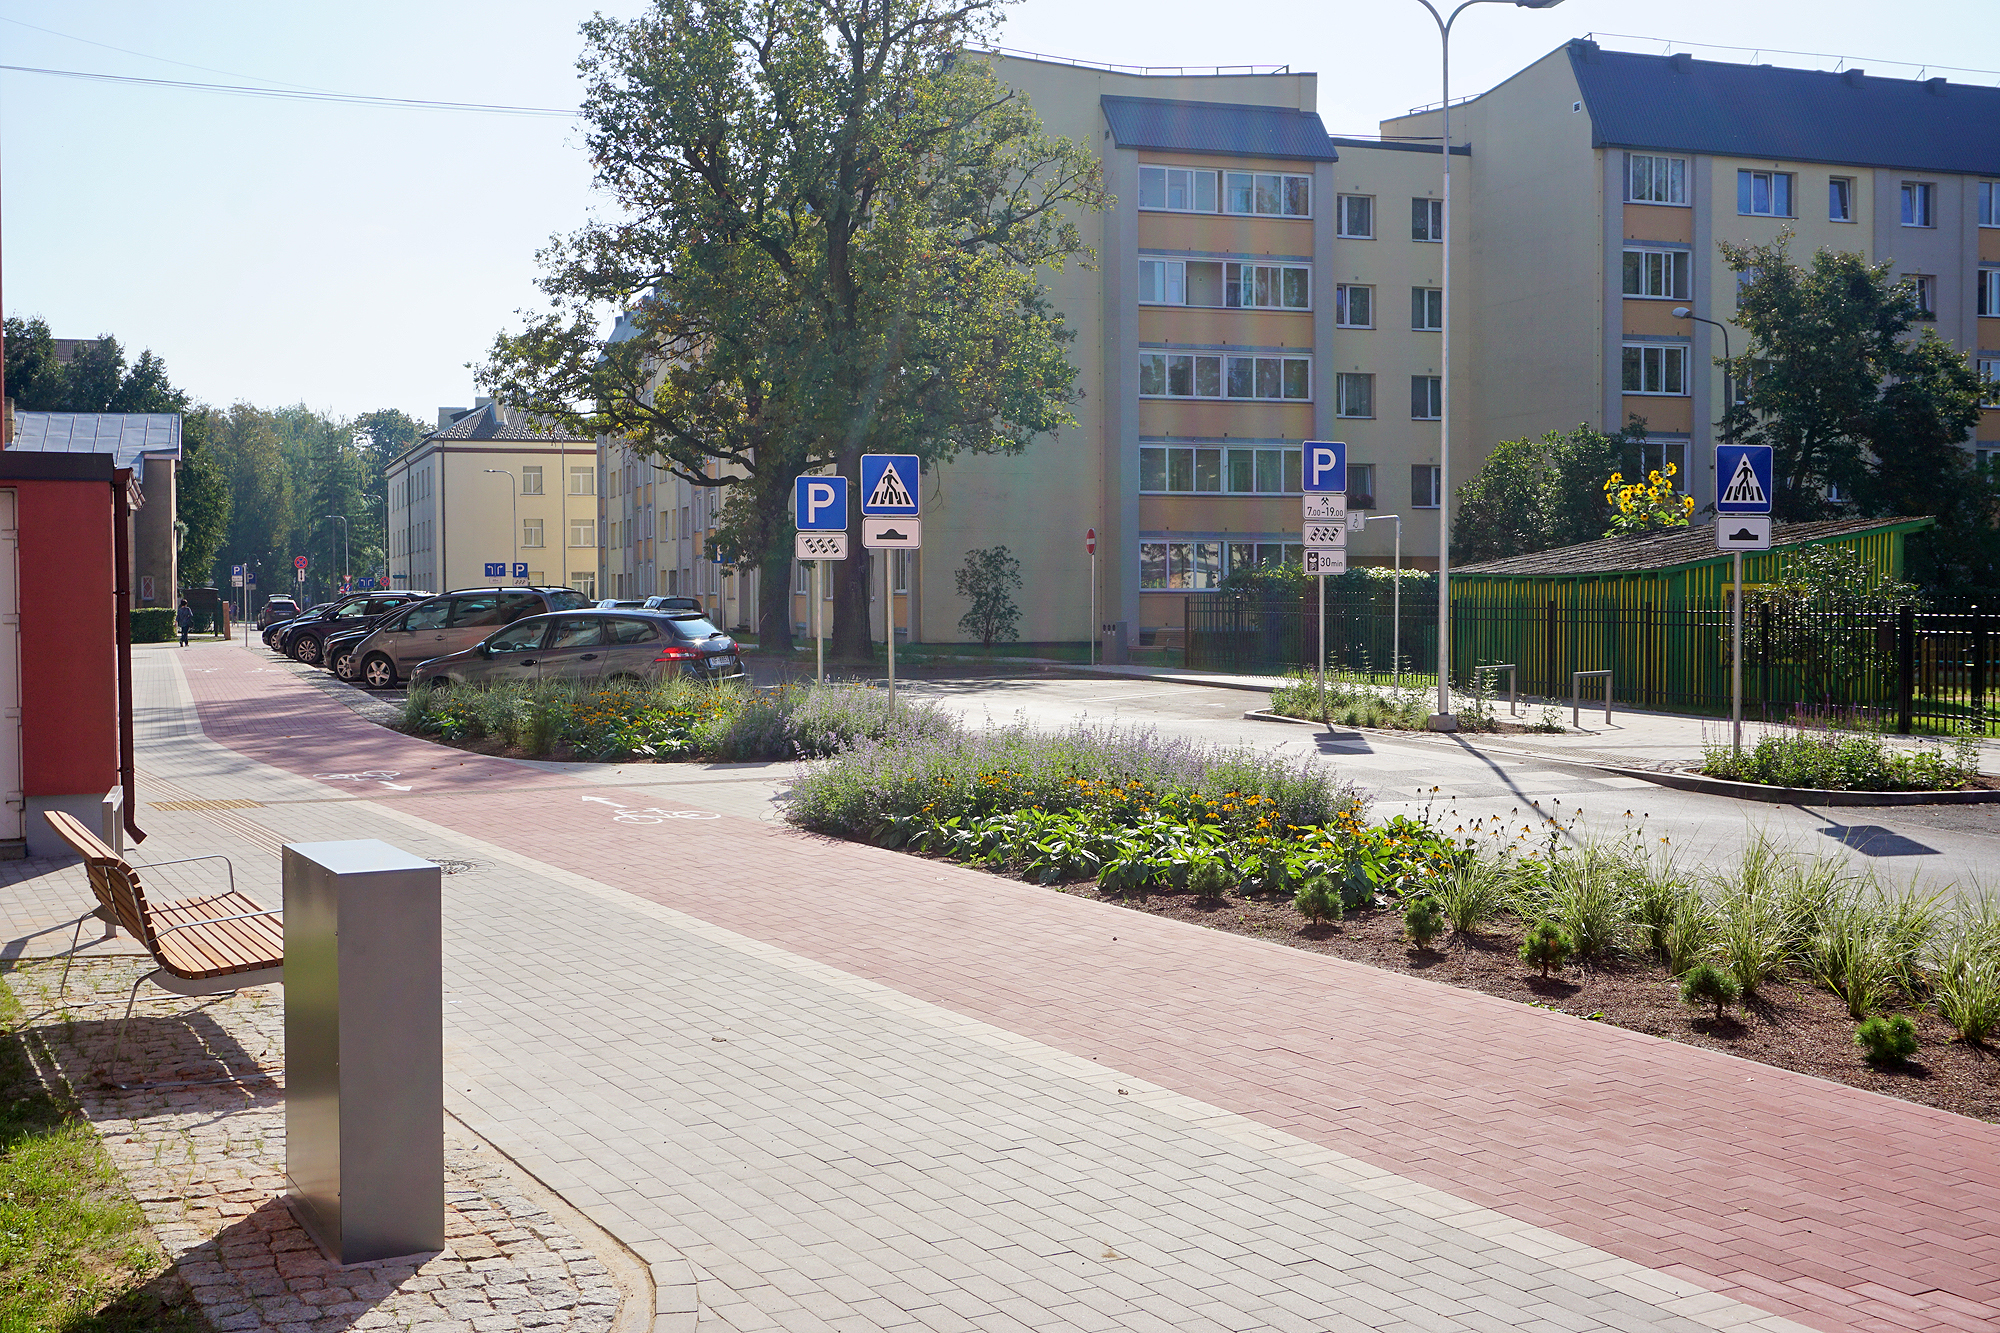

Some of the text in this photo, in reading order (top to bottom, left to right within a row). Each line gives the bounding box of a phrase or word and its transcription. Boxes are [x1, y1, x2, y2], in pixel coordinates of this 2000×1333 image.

[1313, 448, 1336, 486] P
[808, 483, 835, 523] P
[233, 566, 241, 575] P
[515, 564, 525, 577] P
[247, 573, 254, 583] P
